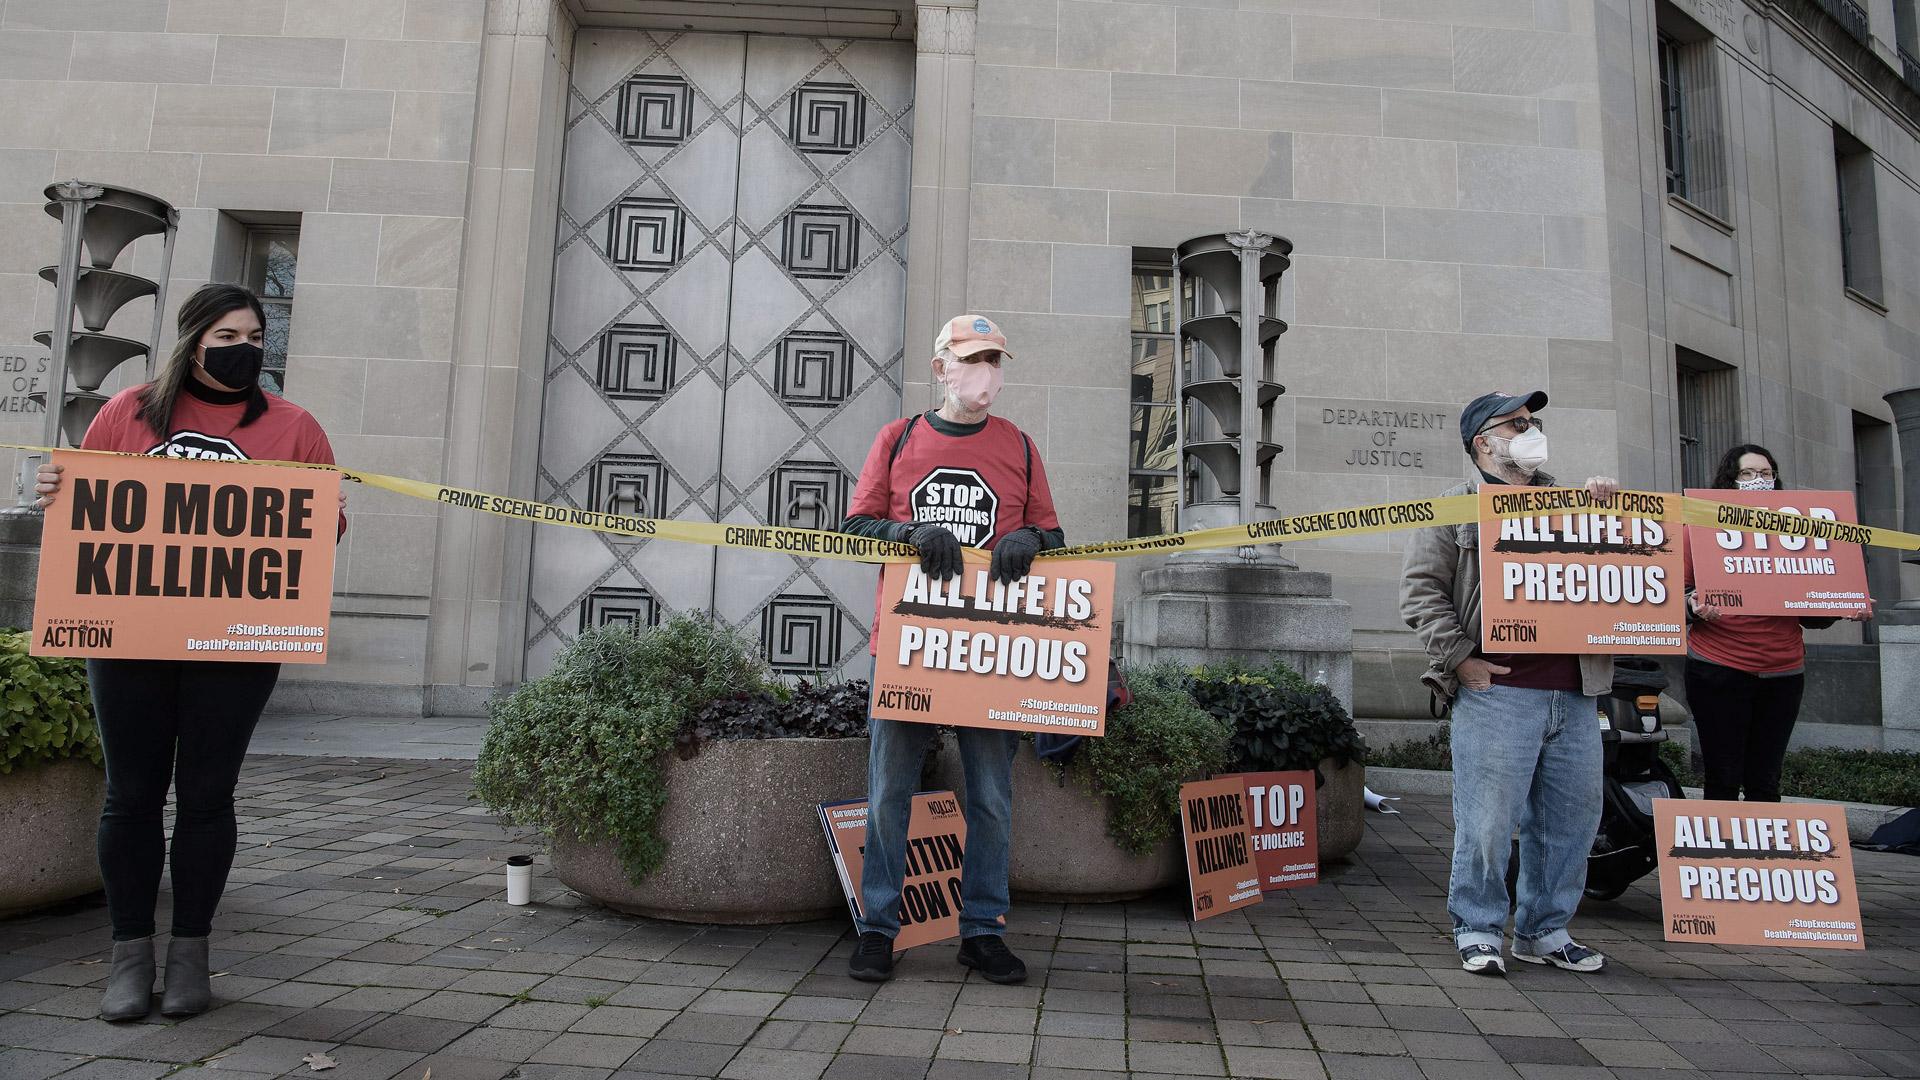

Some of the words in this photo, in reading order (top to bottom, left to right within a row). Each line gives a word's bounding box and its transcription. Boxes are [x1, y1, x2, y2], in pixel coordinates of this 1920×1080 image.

[13, 377, 39, 392] OF
[1322, 408, 1446, 429] DEPARTMENT
[1372, 431, 1397, 447] OF
[1345, 450, 1424, 469] JUSTICE
[926, 482, 984, 508] STOP
[1492, 493, 1533, 514] CRIME
[1535, 490, 1575, 510] SCENE
[1577, 489, 1592, 507] DO
[1623, 493, 1664, 515] CROSS
[71, 478, 147, 533] NO
[162, 482, 314, 539] MORE
[437, 488, 489, 511] CRIME
[491, 497, 541, 519] SCENE
[544, 506, 567, 522] DO
[570, 510, 602, 527] NOT
[604, 513, 656, 535] CROSS
[918, 506, 990, 526] EXECUTIONS
[1247, 518, 1291, 538] CRIME
[1292, 512, 1336, 533] SCENE
[1337, 510, 1358, 529] DO
[1359, 507, 1387, 527] NOT
[1388, 502, 1434, 525] CROSS
[1501, 516, 1555, 542] ALL
[1563, 514, 1624, 545] LIFE
[1632, 516, 1664, 547] IS
[1717, 505, 1754, 528] CRIME
[1755, 511, 1791, 533] SCENE
[1792, 517, 1809, 536] DO
[1809, 519, 1834, 539] NOT
[1834, 523, 1872, 544] CROSS
[725, 527, 771, 549] CRIME
[774, 530, 820, 553] SCENE
[823, 534, 843, 555] DO
[846, 537, 876, 556] NOT
[931, 522, 977, 544] W!
[75, 542, 303, 600] KILLING!
[1723, 556, 1772, 574] STATE
[1774, 558, 1836, 575] KILLING
[902, 564, 965, 608] ALL
[974, 570, 1047, 616] LIFE
[1054, 578, 1092, 621] IS
[1503, 562, 1666, 604] PRECIOUS
[1704, 593, 1743, 607] ACTION
[42, 626, 113, 648] ACTION
[226, 623, 324, 638] #StopExecutions
[1490, 624, 1537, 642] ACTION
[1613, 621, 1681, 633] #StopExecutions
[187, 638, 323, 653] DeathPenaltyAction.org
[1587, 634, 1681, 647] DeathPenaltyAction.org
[898, 625, 1087, 683] PRECIOUS
[905, 685, 933, 693] PENALTY
[877, 690, 932, 712] ACTION
[1020, 698, 1098, 715] #StopExecutions
[988, 709, 1098, 730] DeathPenaltyAction.org
[1188, 796, 1208, 834] NO
[1207, 793, 1245, 830] MORE
[1249, 784, 1305, 828] TOP
[1261, 831, 1305, 850] VIOLENCE
[1674, 815, 1726, 849] ALL
[1730, 817, 1792, 851] LIFE
[1796, 819, 1831, 853] IS
[1195, 831, 1249, 875] KILLING!
[947, 877, 964, 913] O
[1679, 866, 1838, 904] PRECIOUS
[896, 880, 952, 927] MOR
[1672, 919, 1716, 935] ACTION
[1789, 919, 1857, 930] #StopExecutions
[1764, 930, 1858, 942] DeathPenaltyAction.org
